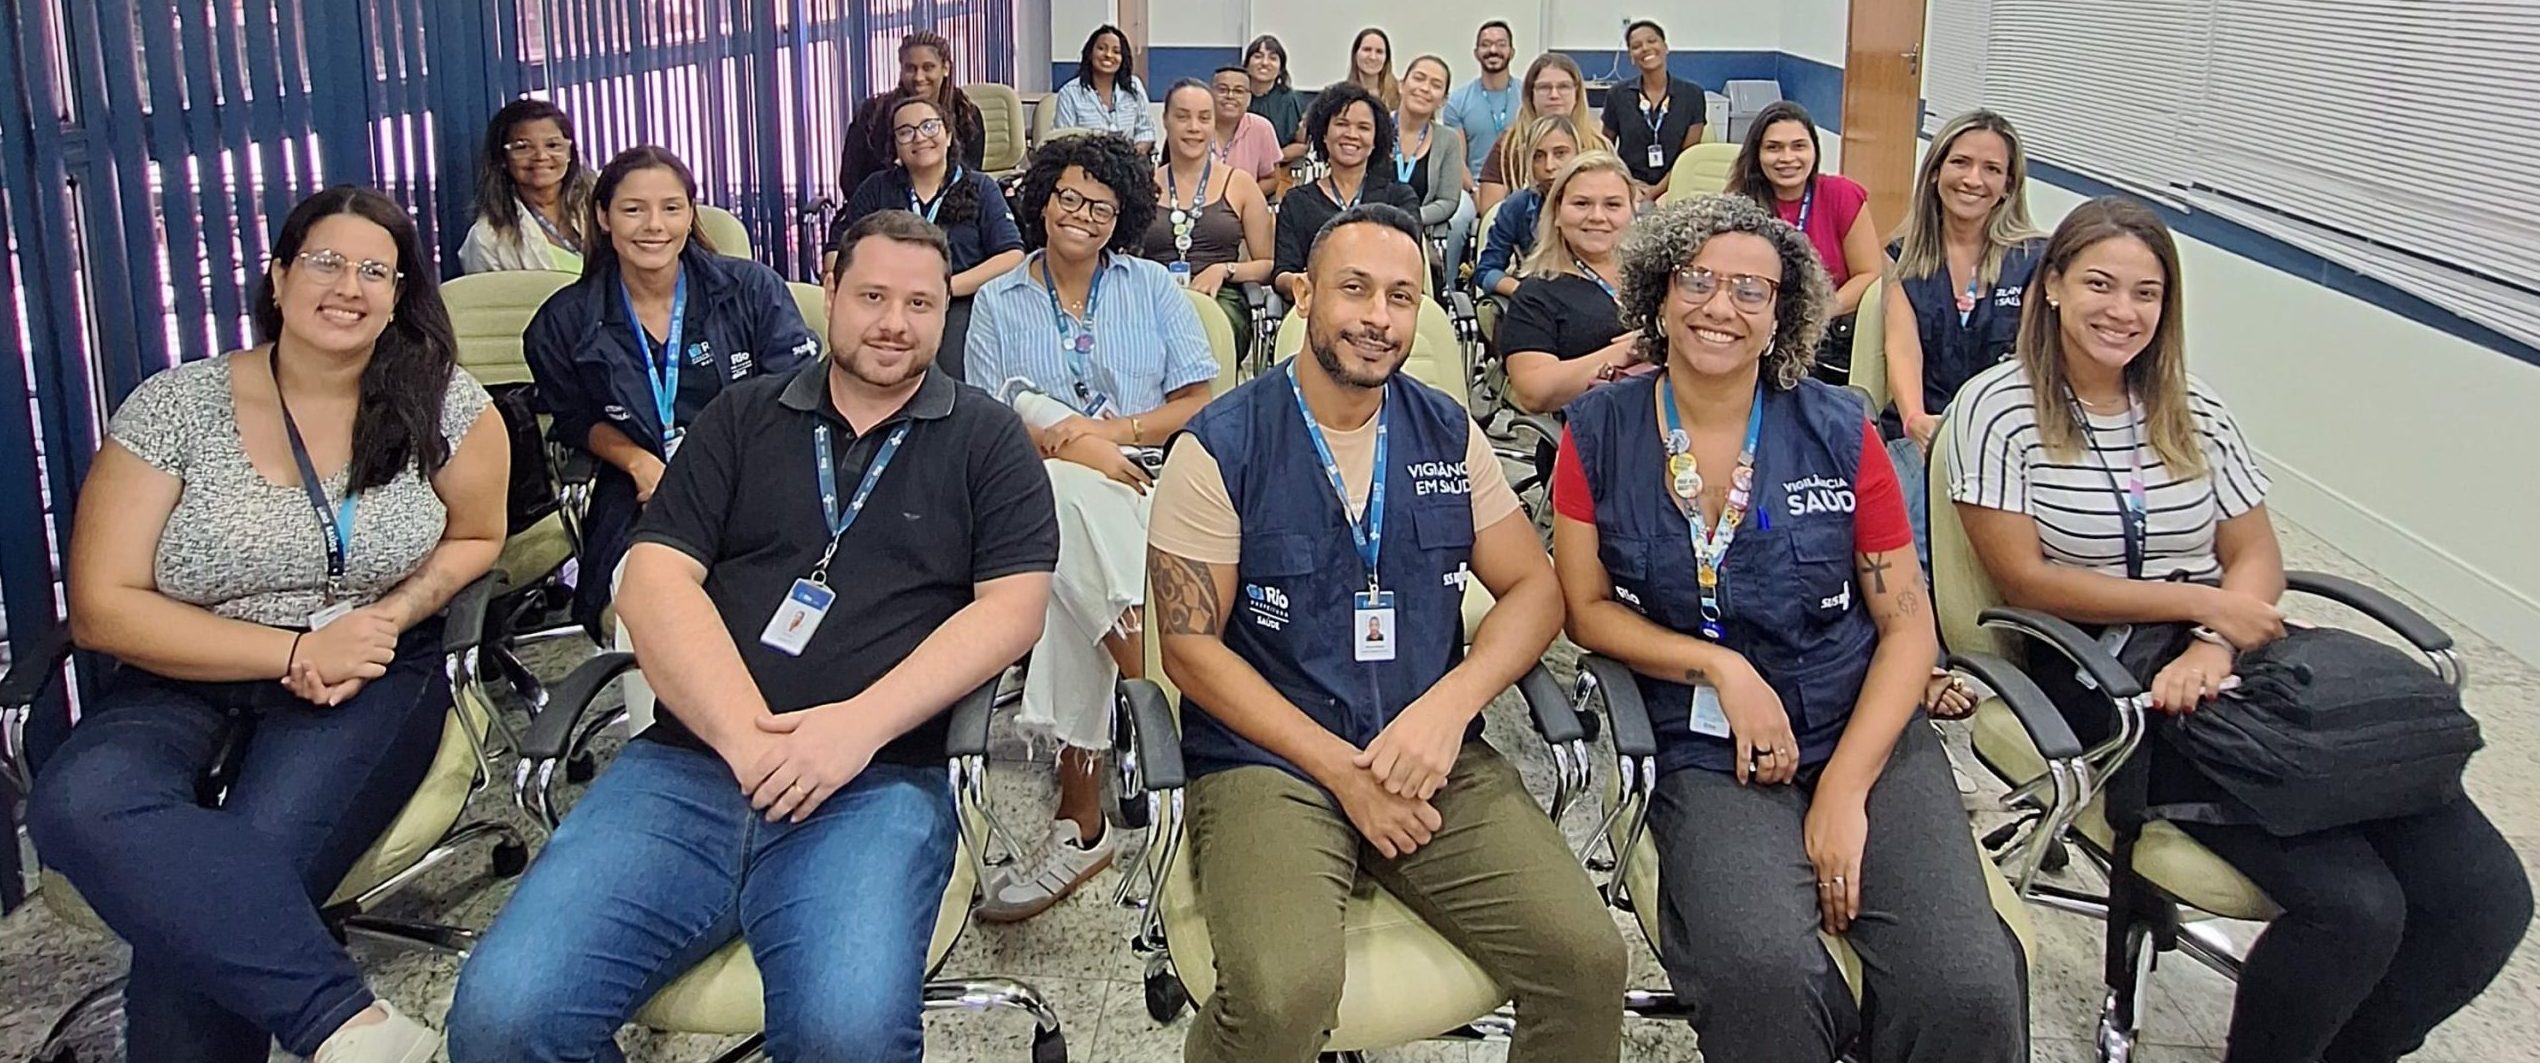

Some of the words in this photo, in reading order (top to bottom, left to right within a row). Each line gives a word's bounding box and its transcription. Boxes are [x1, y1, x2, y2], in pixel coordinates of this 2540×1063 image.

[1407, 461, 1468, 479] VIGIÂNC
[1415, 479, 1438, 496] EM
[1265, 586, 1289, 610] Rio
[1615, 585, 1641, 605] Rio
[1256, 615, 1281, 631] SAÚDE
